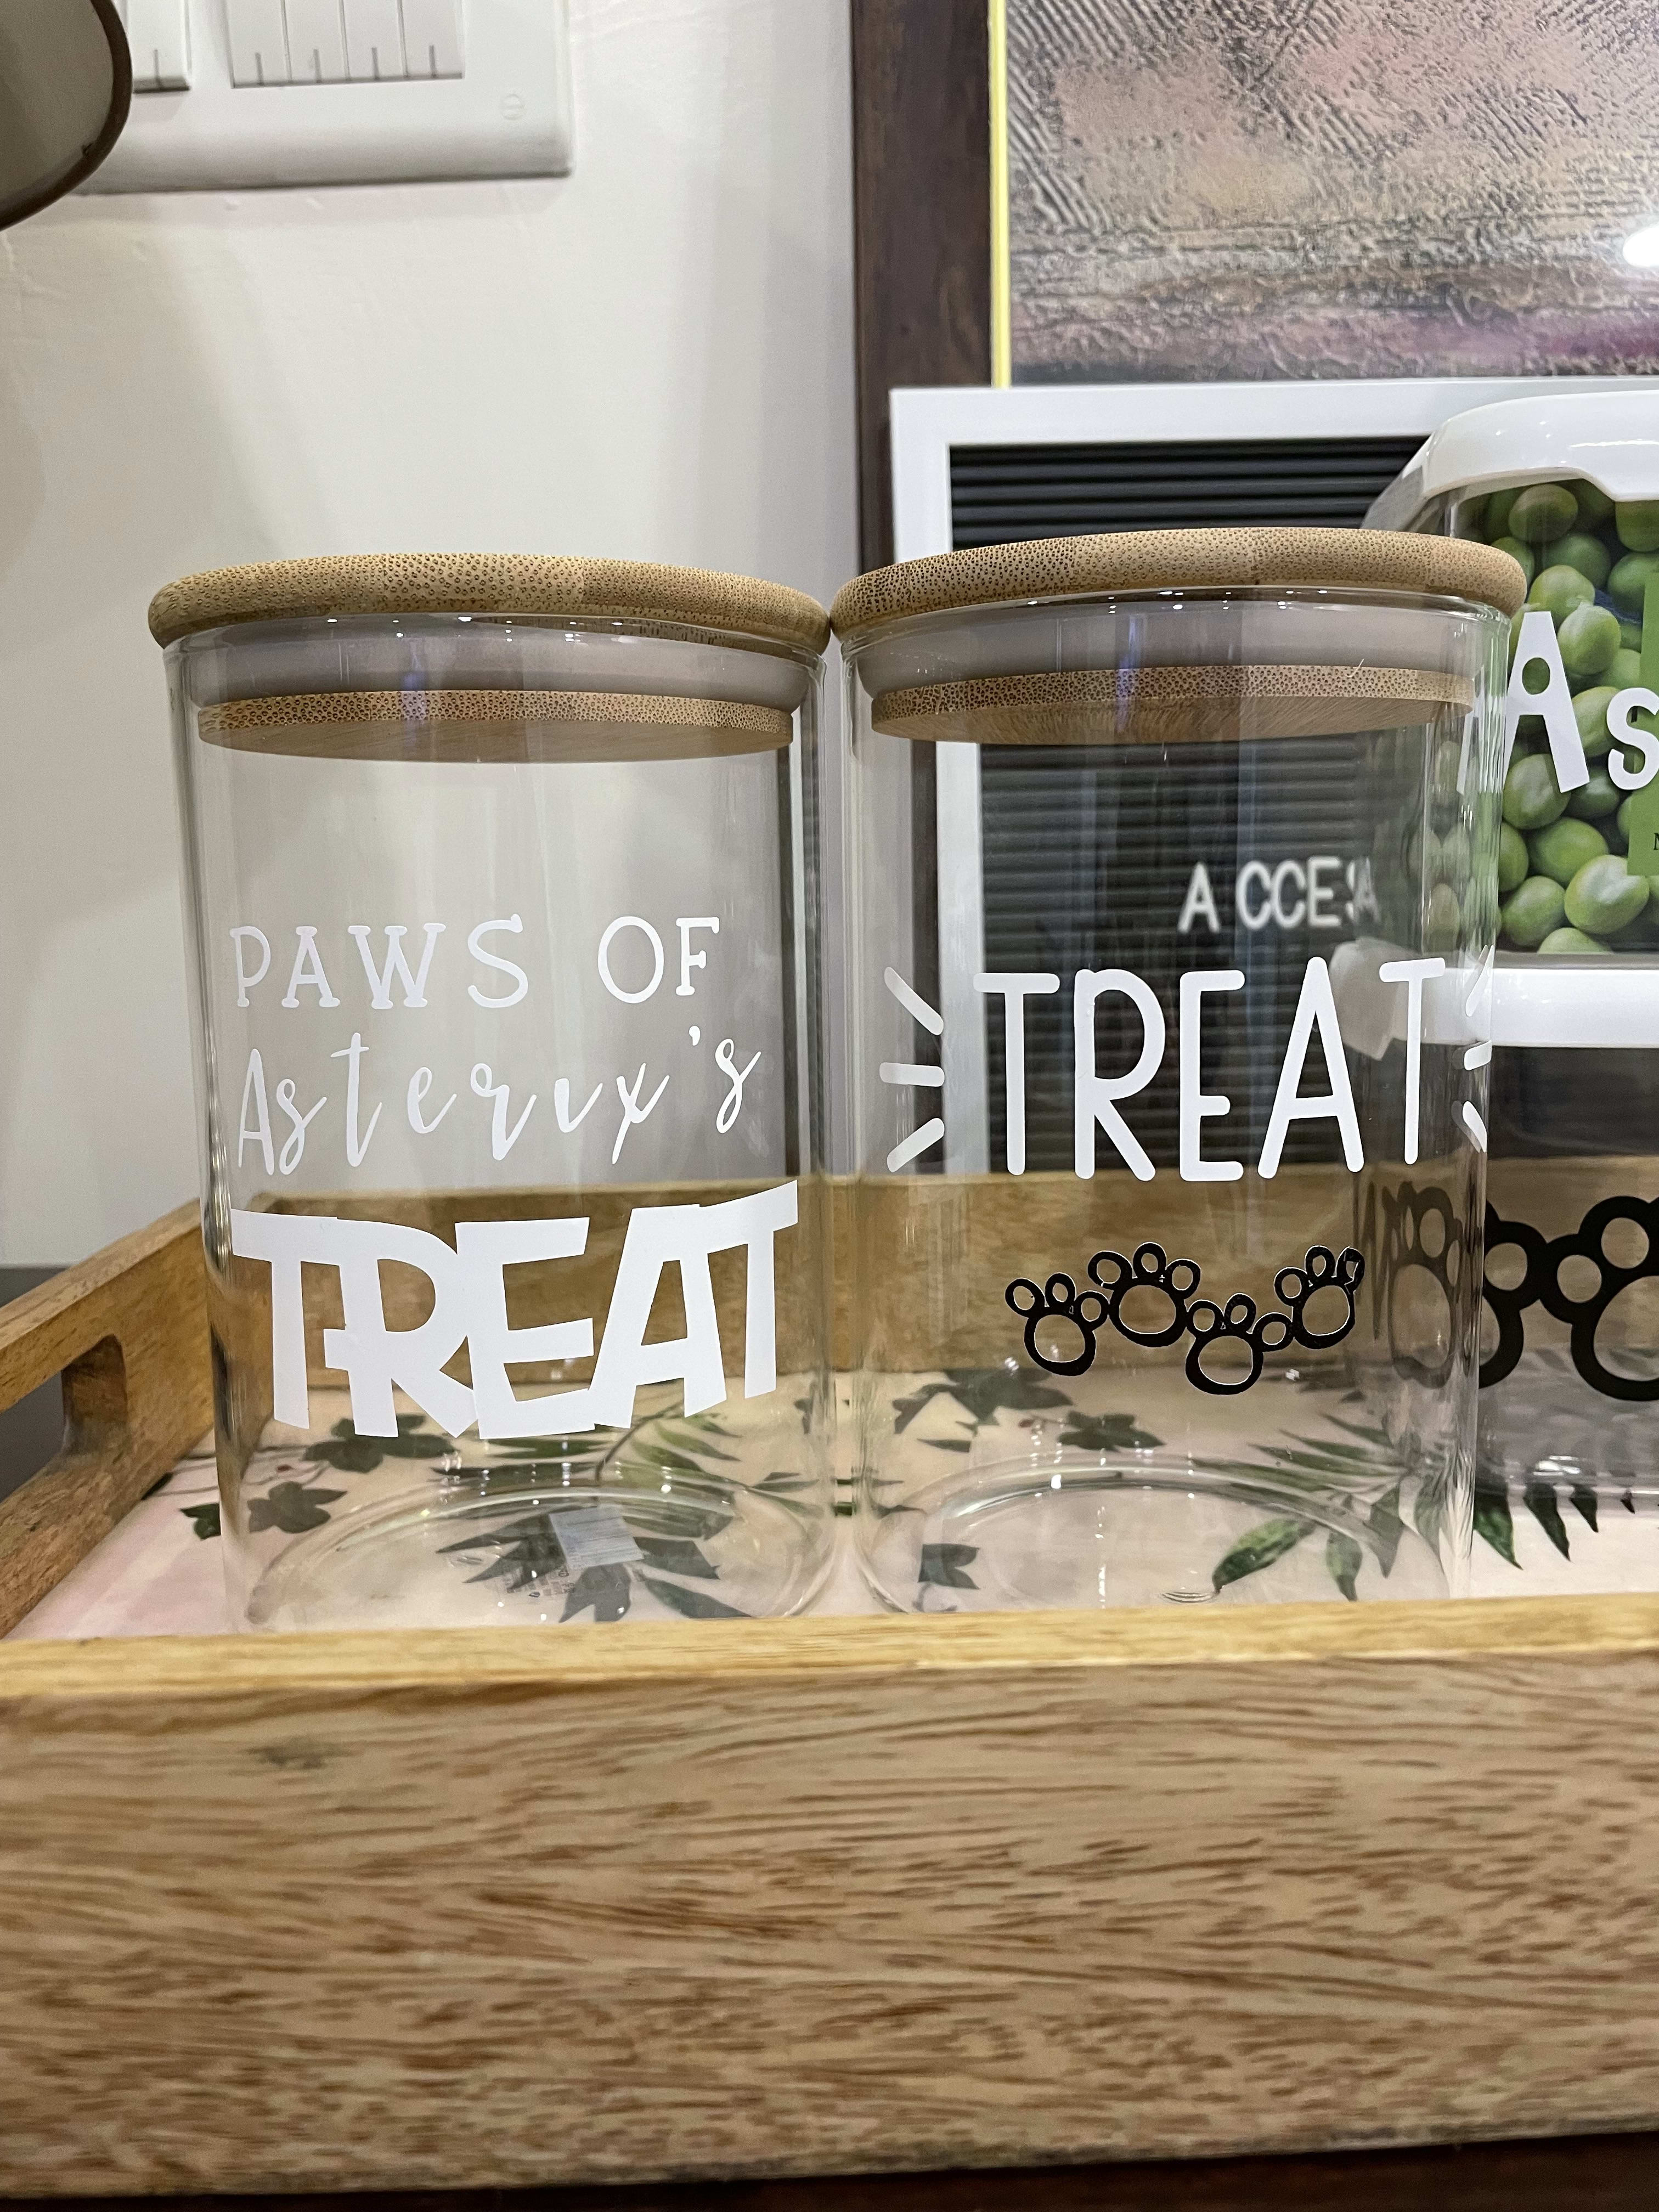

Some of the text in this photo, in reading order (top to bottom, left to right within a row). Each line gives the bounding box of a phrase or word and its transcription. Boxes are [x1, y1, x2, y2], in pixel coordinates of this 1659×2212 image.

[230, 915, 720, 1009] PAWS OF
[973, 956, 1445, 1182] TREAT
[230, 1180, 798, 1438] TREAT
